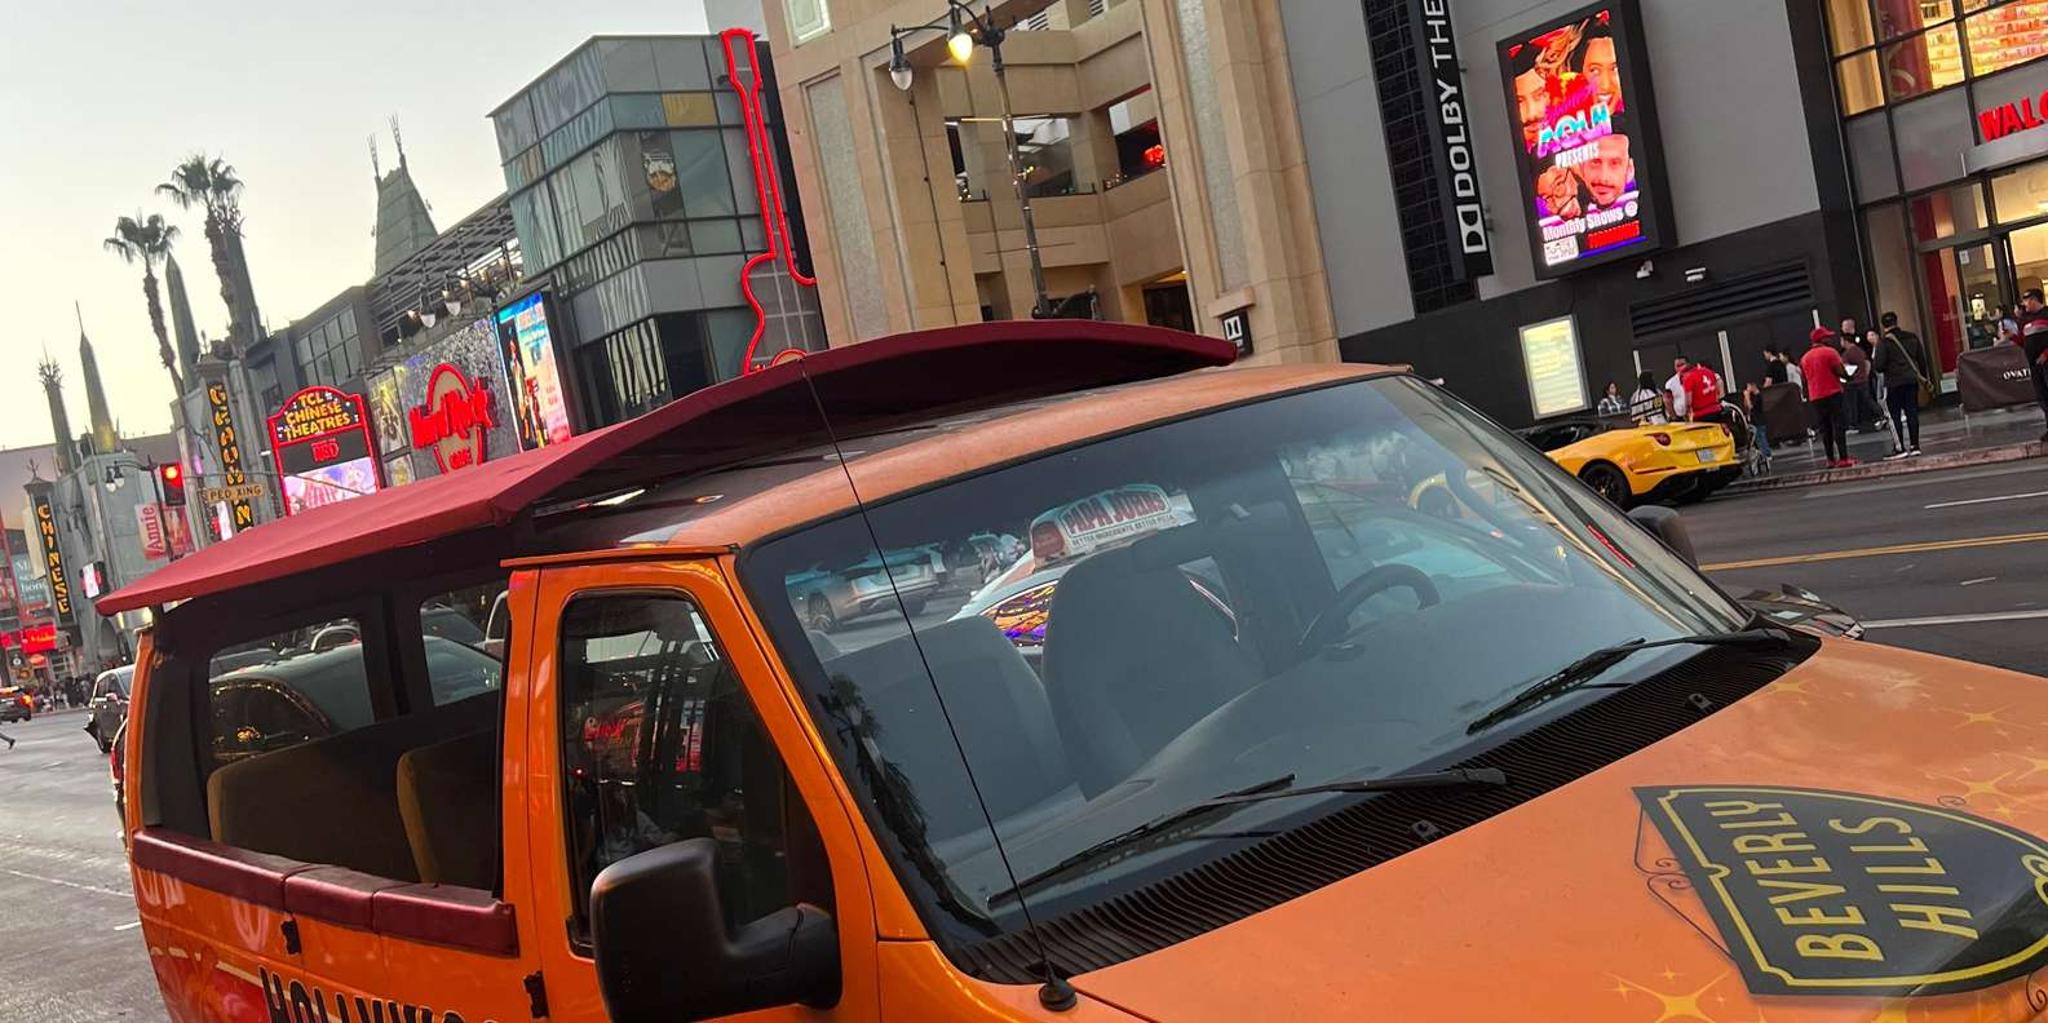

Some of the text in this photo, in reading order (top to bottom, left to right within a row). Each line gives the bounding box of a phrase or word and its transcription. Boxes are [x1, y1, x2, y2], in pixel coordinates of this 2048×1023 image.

[1424, 0, 1476, 198] DOLBY THE
[1542, 217, 1586, 242] Monthly
[1586, 207, 1624, 229] Shows
[286, 402, 342, 425] CHINESE
[298, 391, 324, 408] TCL
[284, 412, 350, 441] THEATRES
[210, 485, 262, 500] PED XING
[142, 507, 164, 550] Annie
[1064, 497, 1115, 536] PAPA
[37, 504, 71, 614] CHINESE
[1704, 800, 1884, 962] BEVERLY
[1828, 816, 1980, 940] HILLS
